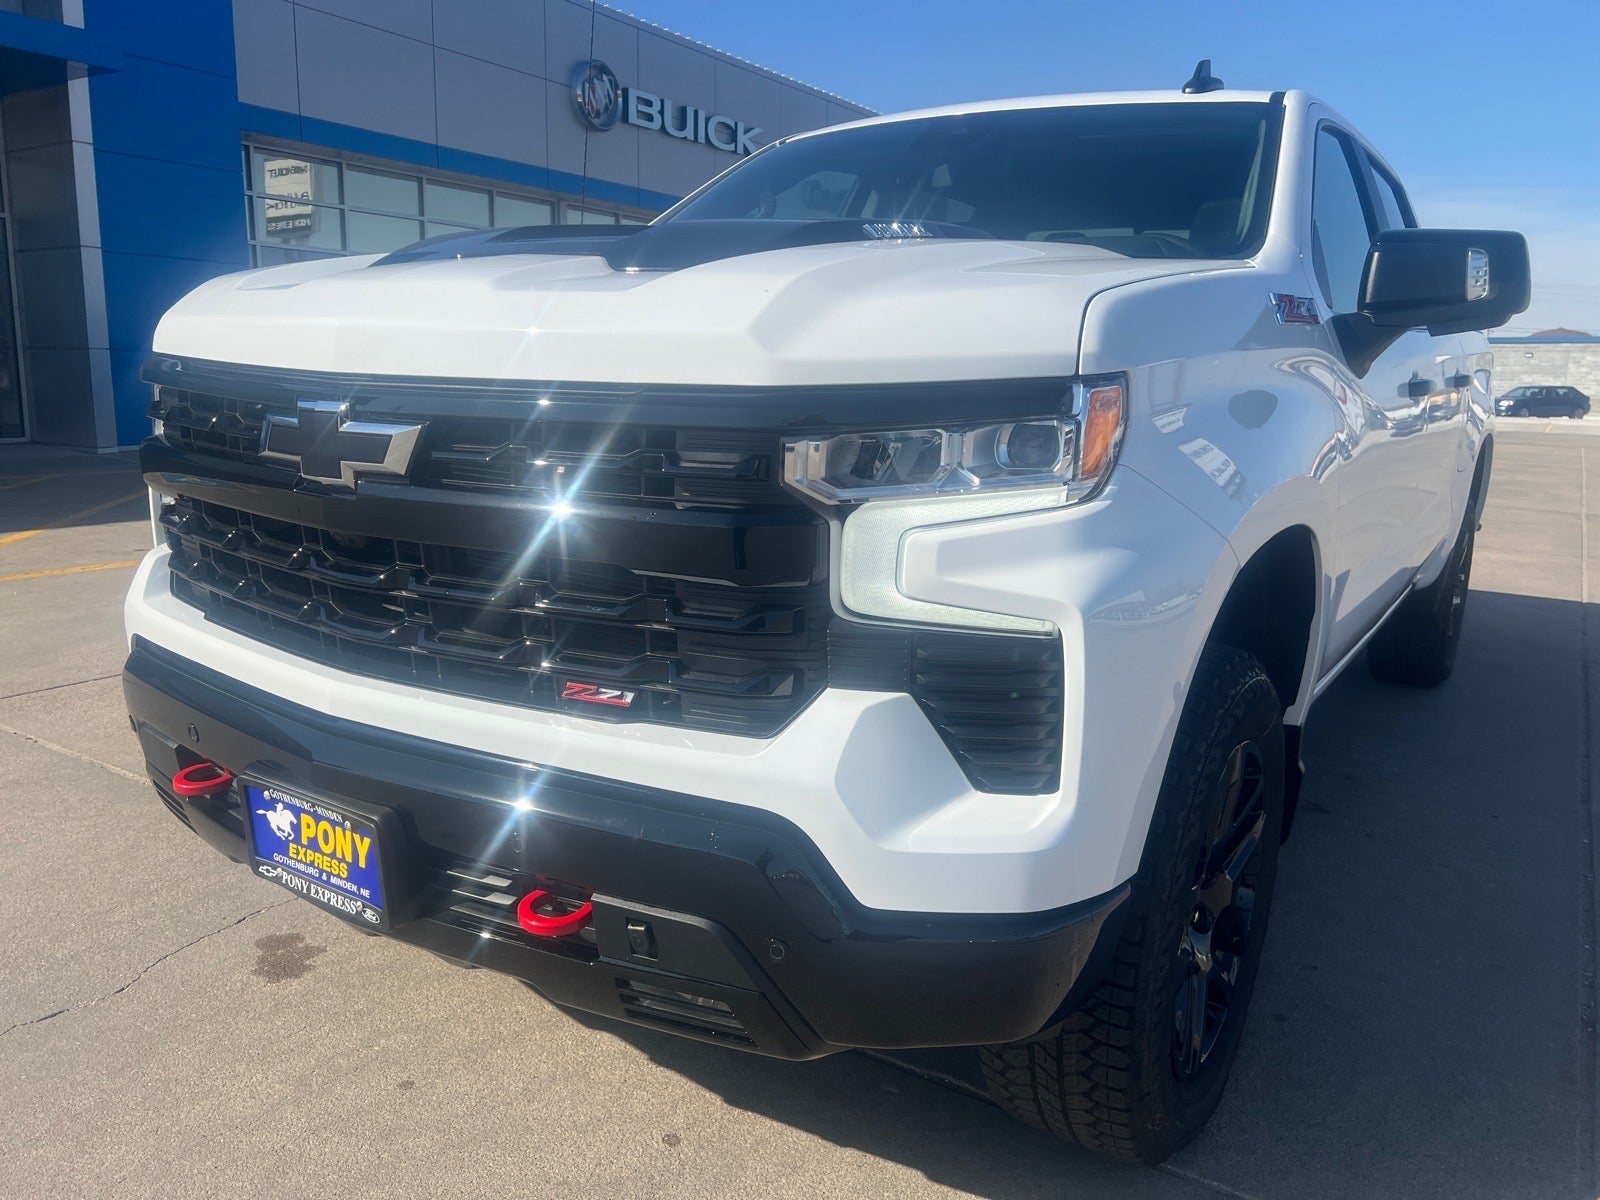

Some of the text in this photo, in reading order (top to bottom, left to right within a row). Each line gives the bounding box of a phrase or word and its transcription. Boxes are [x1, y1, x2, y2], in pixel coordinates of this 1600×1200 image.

[624, 87, 764, 155] BUICK
[1269, 292, 1320, 325] Z71
[562, 681, 635, 707] Z71
[289, 842, 348, 879] EXPRESS
[301, 812, 371, 869] PONY
[273, 853, 371, 899] GOTHENBURG & MINDEN, NE
[281, 870, 358, 915] PONY EXPRESS
